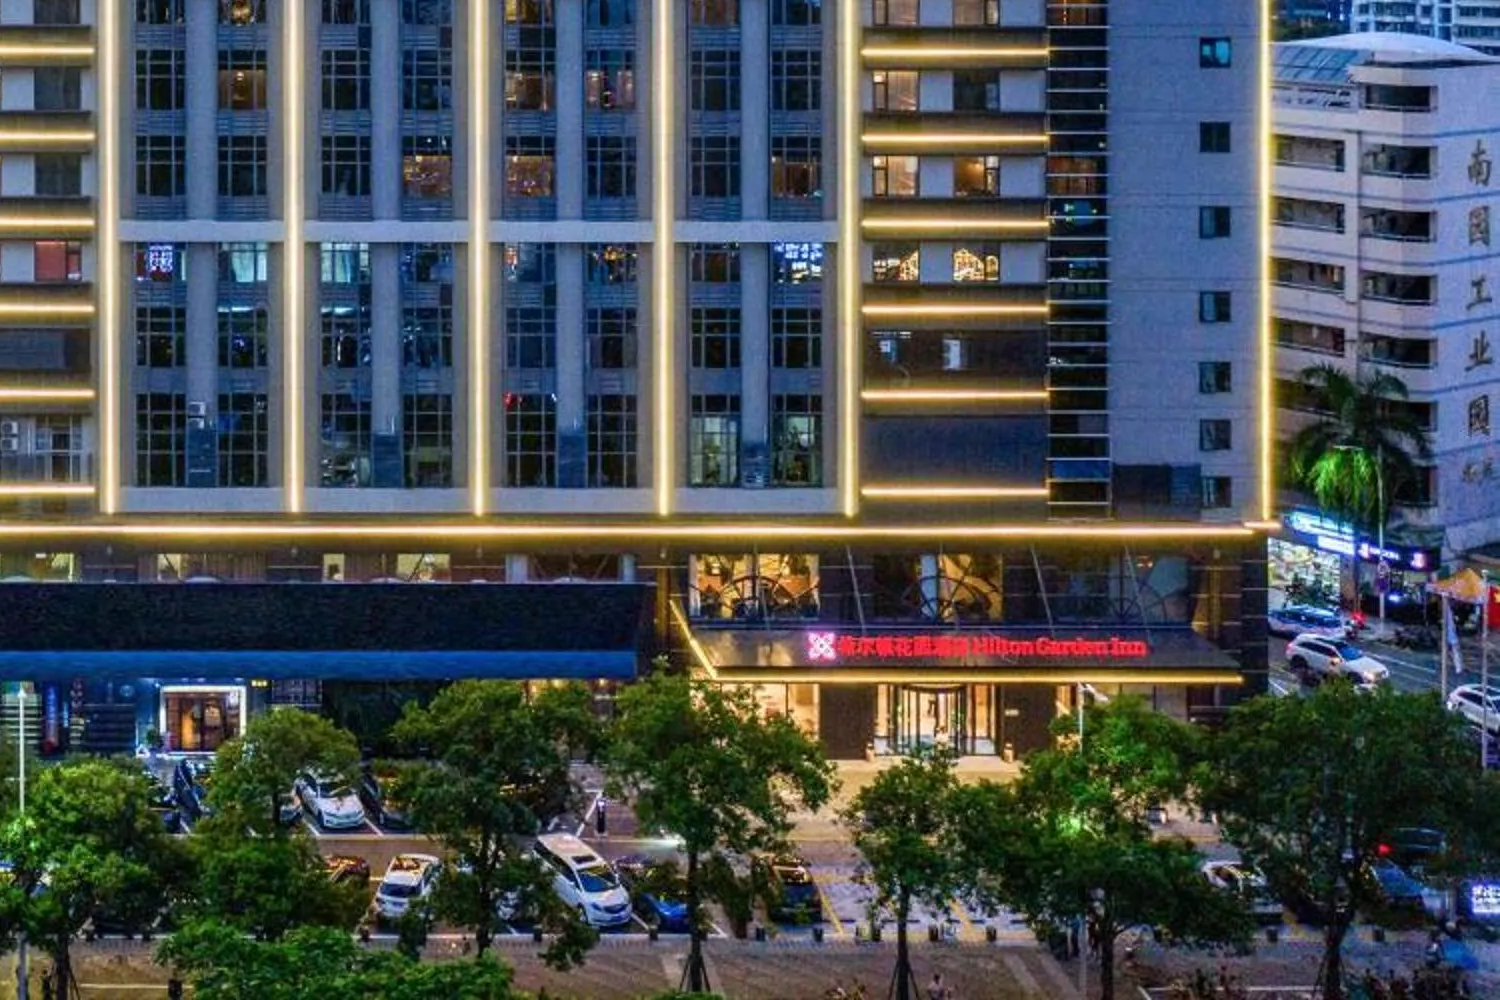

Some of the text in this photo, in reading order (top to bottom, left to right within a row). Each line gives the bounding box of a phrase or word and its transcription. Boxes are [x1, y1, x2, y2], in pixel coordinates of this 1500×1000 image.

[972, 636, 1146, 656] Hilton Garden Inn
